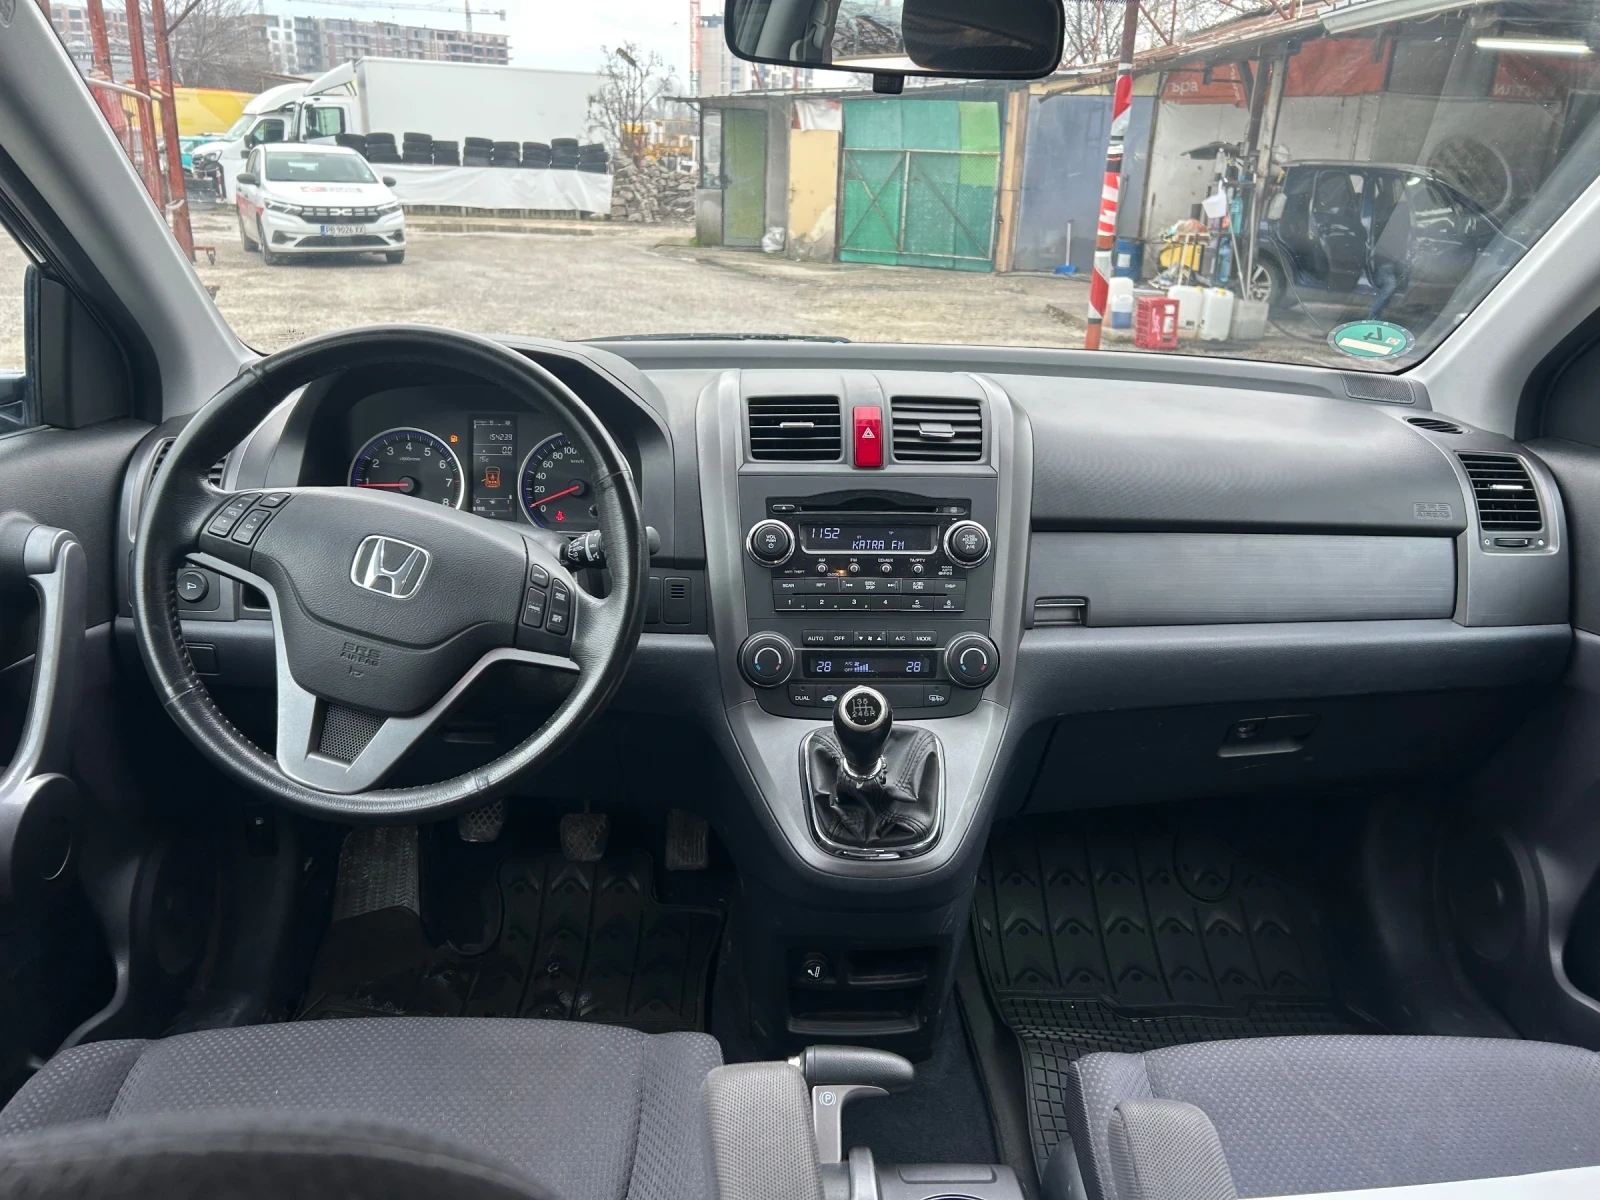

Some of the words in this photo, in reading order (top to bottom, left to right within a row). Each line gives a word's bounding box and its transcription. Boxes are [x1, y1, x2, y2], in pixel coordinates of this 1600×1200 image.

[489, 433, 513, 441] 154239
[386, 446, 394, 456] 3
[405, 442, 413, 452] 4
[424, 448, 431, 457] 5
[552, 452, 564, 460] 80
[372, 459, 380, 468] 2
[439, 460, 446, 469] 6
[445, 478, 452, 488] 7
[540, 504, 546, 512] 0
[891, 540, 905, 550] FM
[816, 661, 832, 673] 28
[906, 661, 922, 673] 28
